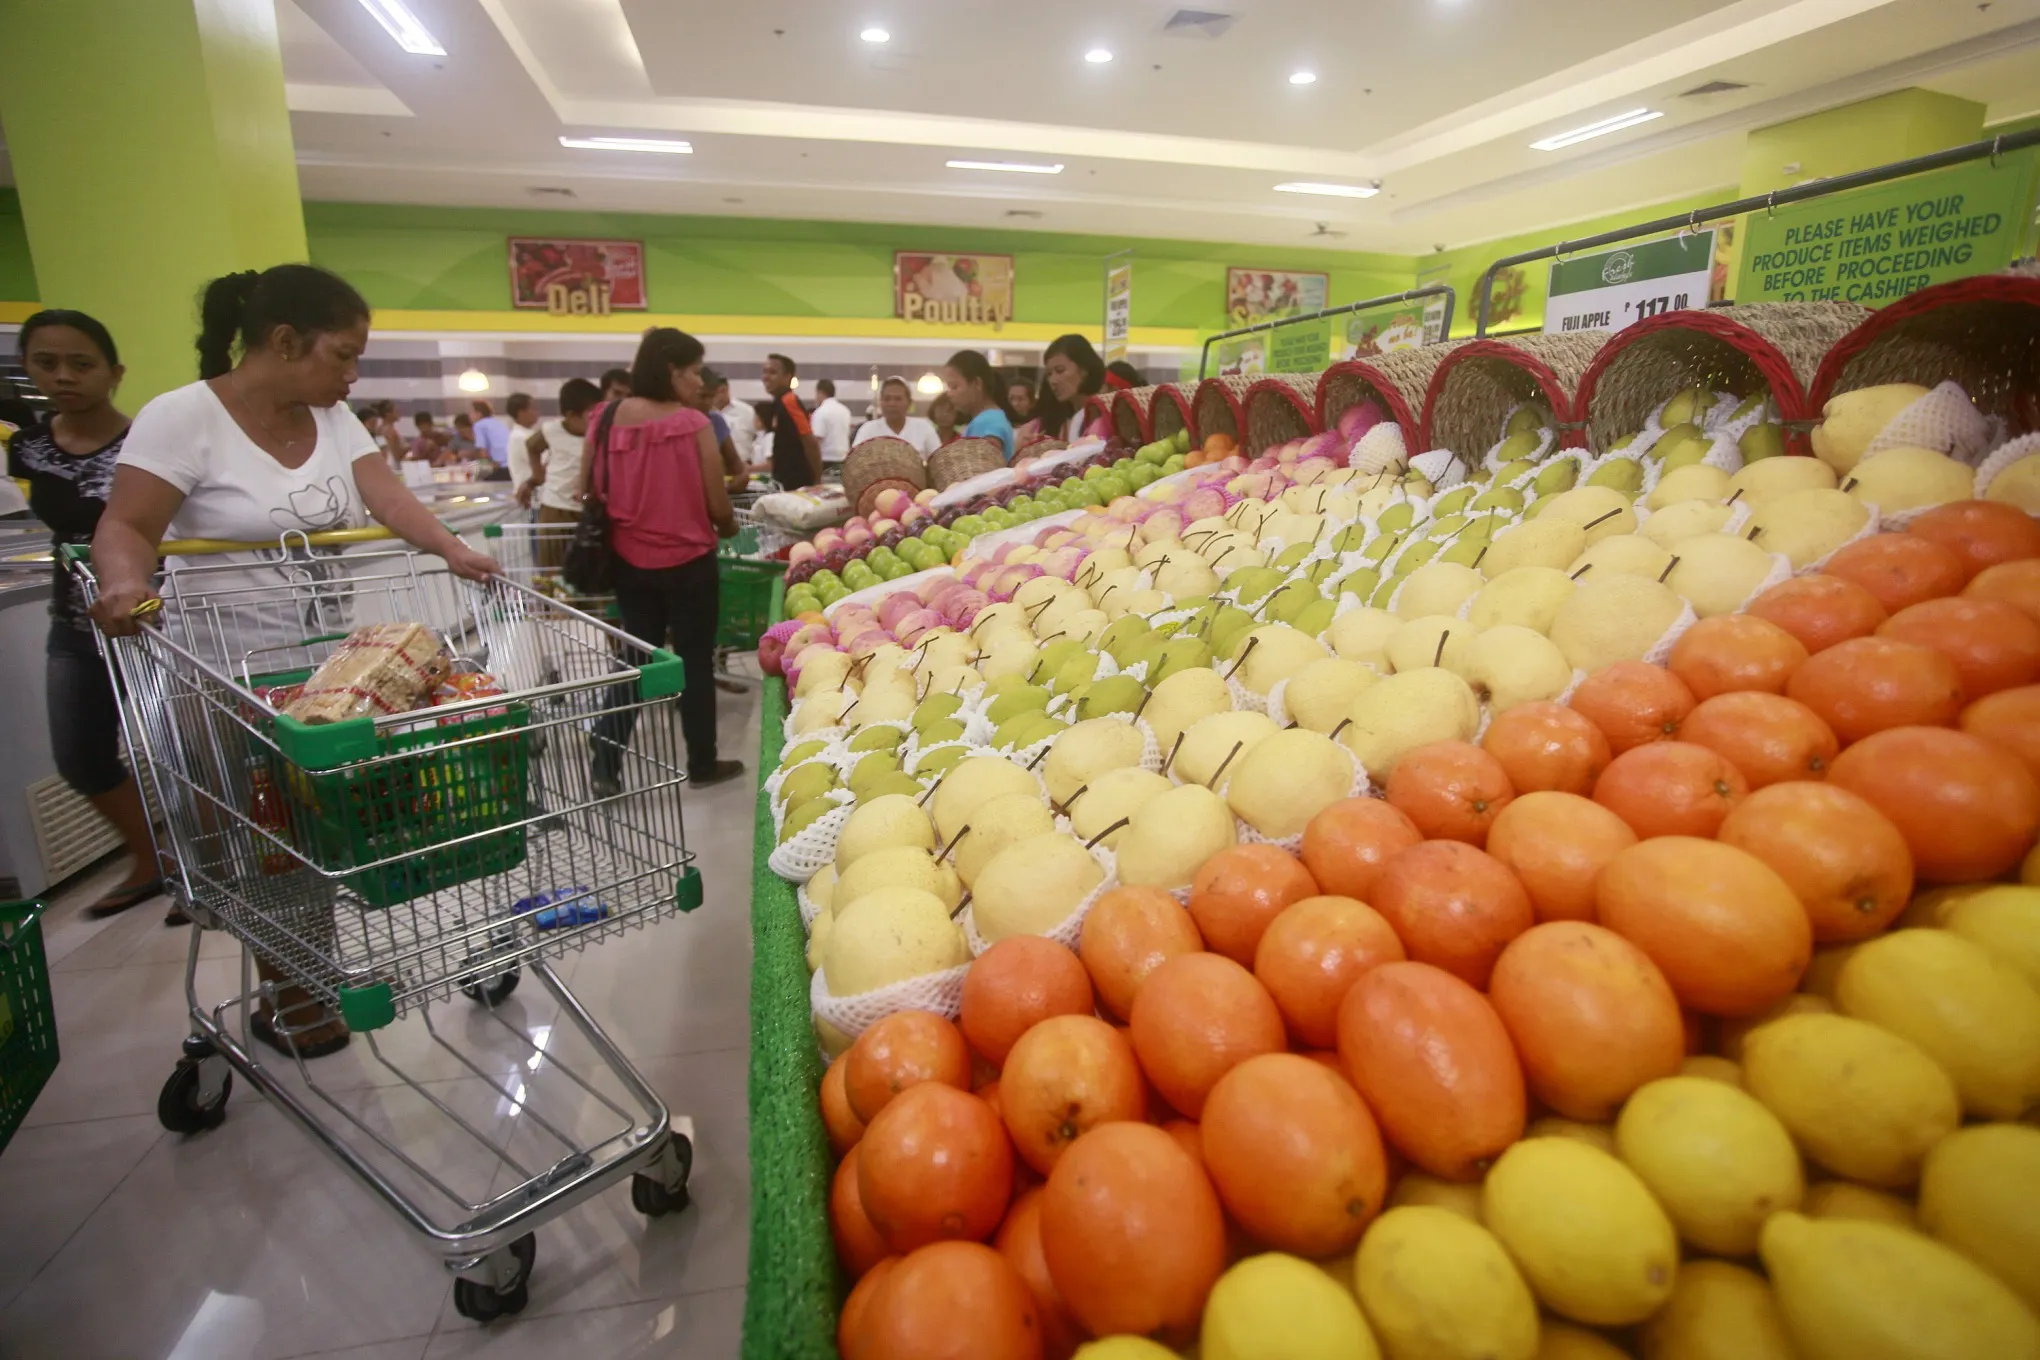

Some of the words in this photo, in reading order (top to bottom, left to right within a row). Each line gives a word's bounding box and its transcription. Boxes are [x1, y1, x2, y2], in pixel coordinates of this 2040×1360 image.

[1785, 218, 1845, 246] PLEASE
[1850, 207, 1899, 234] HAVE
[1906, 194, 1964, 223] YOUR
[1752, 243, 1833, 273] PRODUCE
[1838, 232, 1892, 259] ITEMS
[1899, 213, 2002, 248] WEIGHED
[1763, 266, 1826, 292] BEFORE
[1836, 243, 1973, 281] PROCEEDING
[547, 282, 612, 317] Deli
[1811, 286, 1841, 302] THE
[1846, 274, 1931, 302] CASHIER
[903, 292, 1006, 331] Poultry
[1562, 316, 1580, 332] FUJI
[1582, 310, 1611, 330] APPLE
[1635, 296, 1670, 321] 117
